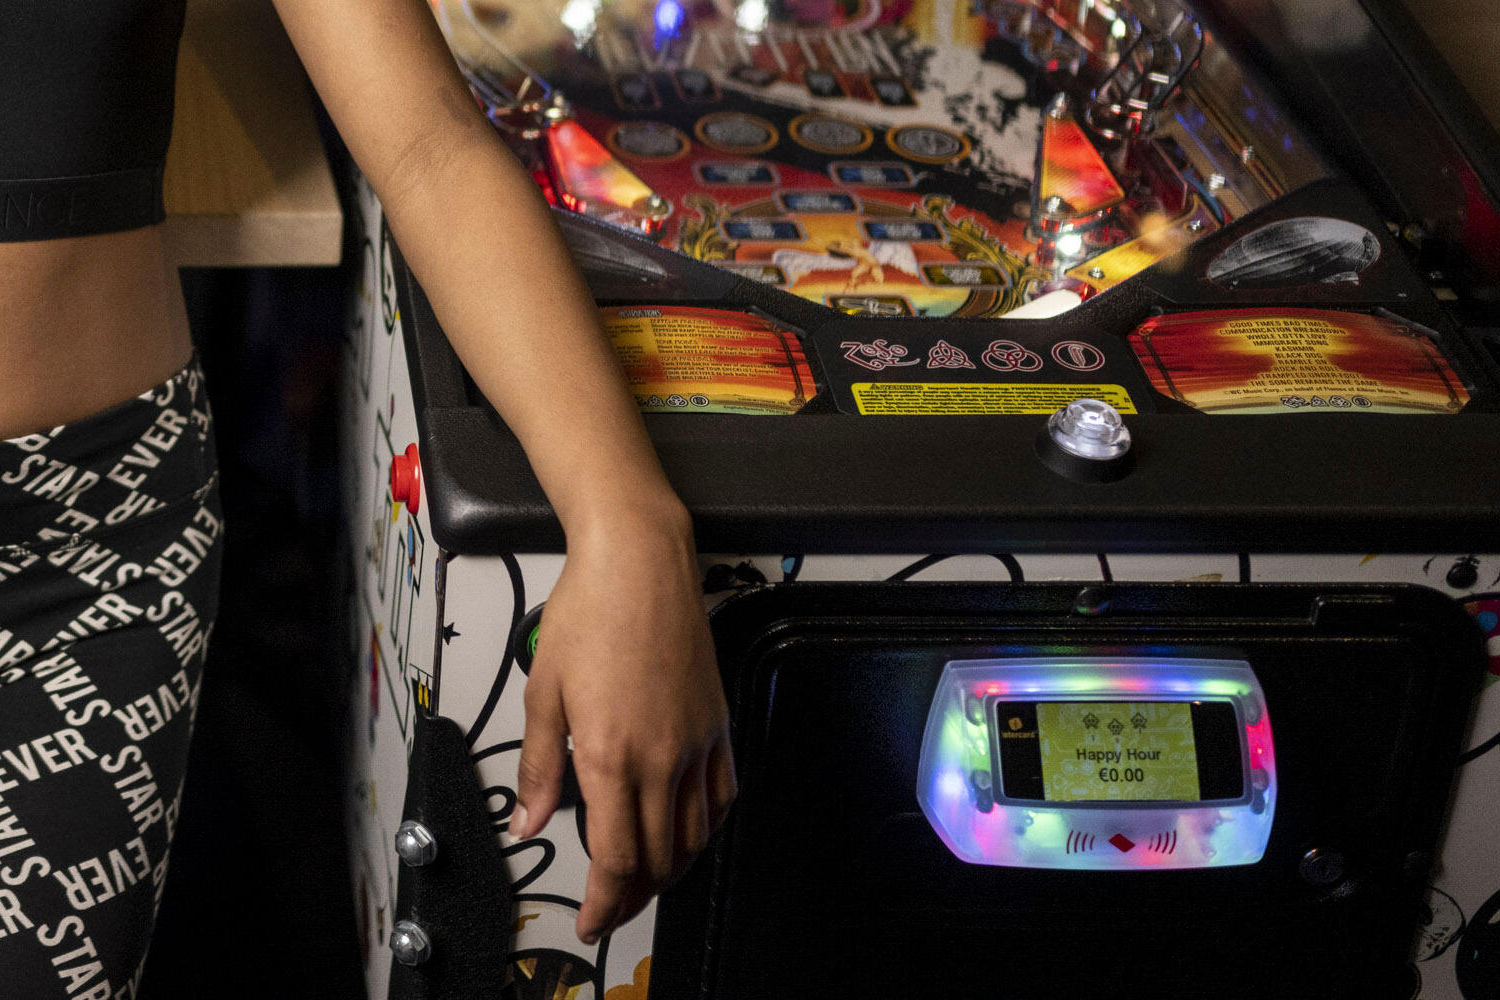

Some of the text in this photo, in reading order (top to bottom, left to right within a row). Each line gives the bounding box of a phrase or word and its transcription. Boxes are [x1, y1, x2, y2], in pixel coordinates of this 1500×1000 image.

[1219, 327, 1291, 335] COMMUNICATION
[1, 454, 100, 506] STAR
[106, 409, 188, 489] EVER
[32, 652, 111, 726] STAR
[113, 669, 189, 741] EVER
[1001, 731, 1037, 739] ntercard
[1076, 748, 1160, 763] Happy Hour
[100, 745, 164, 834] STAR
[1099, 768, 1144, 783] €0.00
[53, 837, 151, 911] EVER
